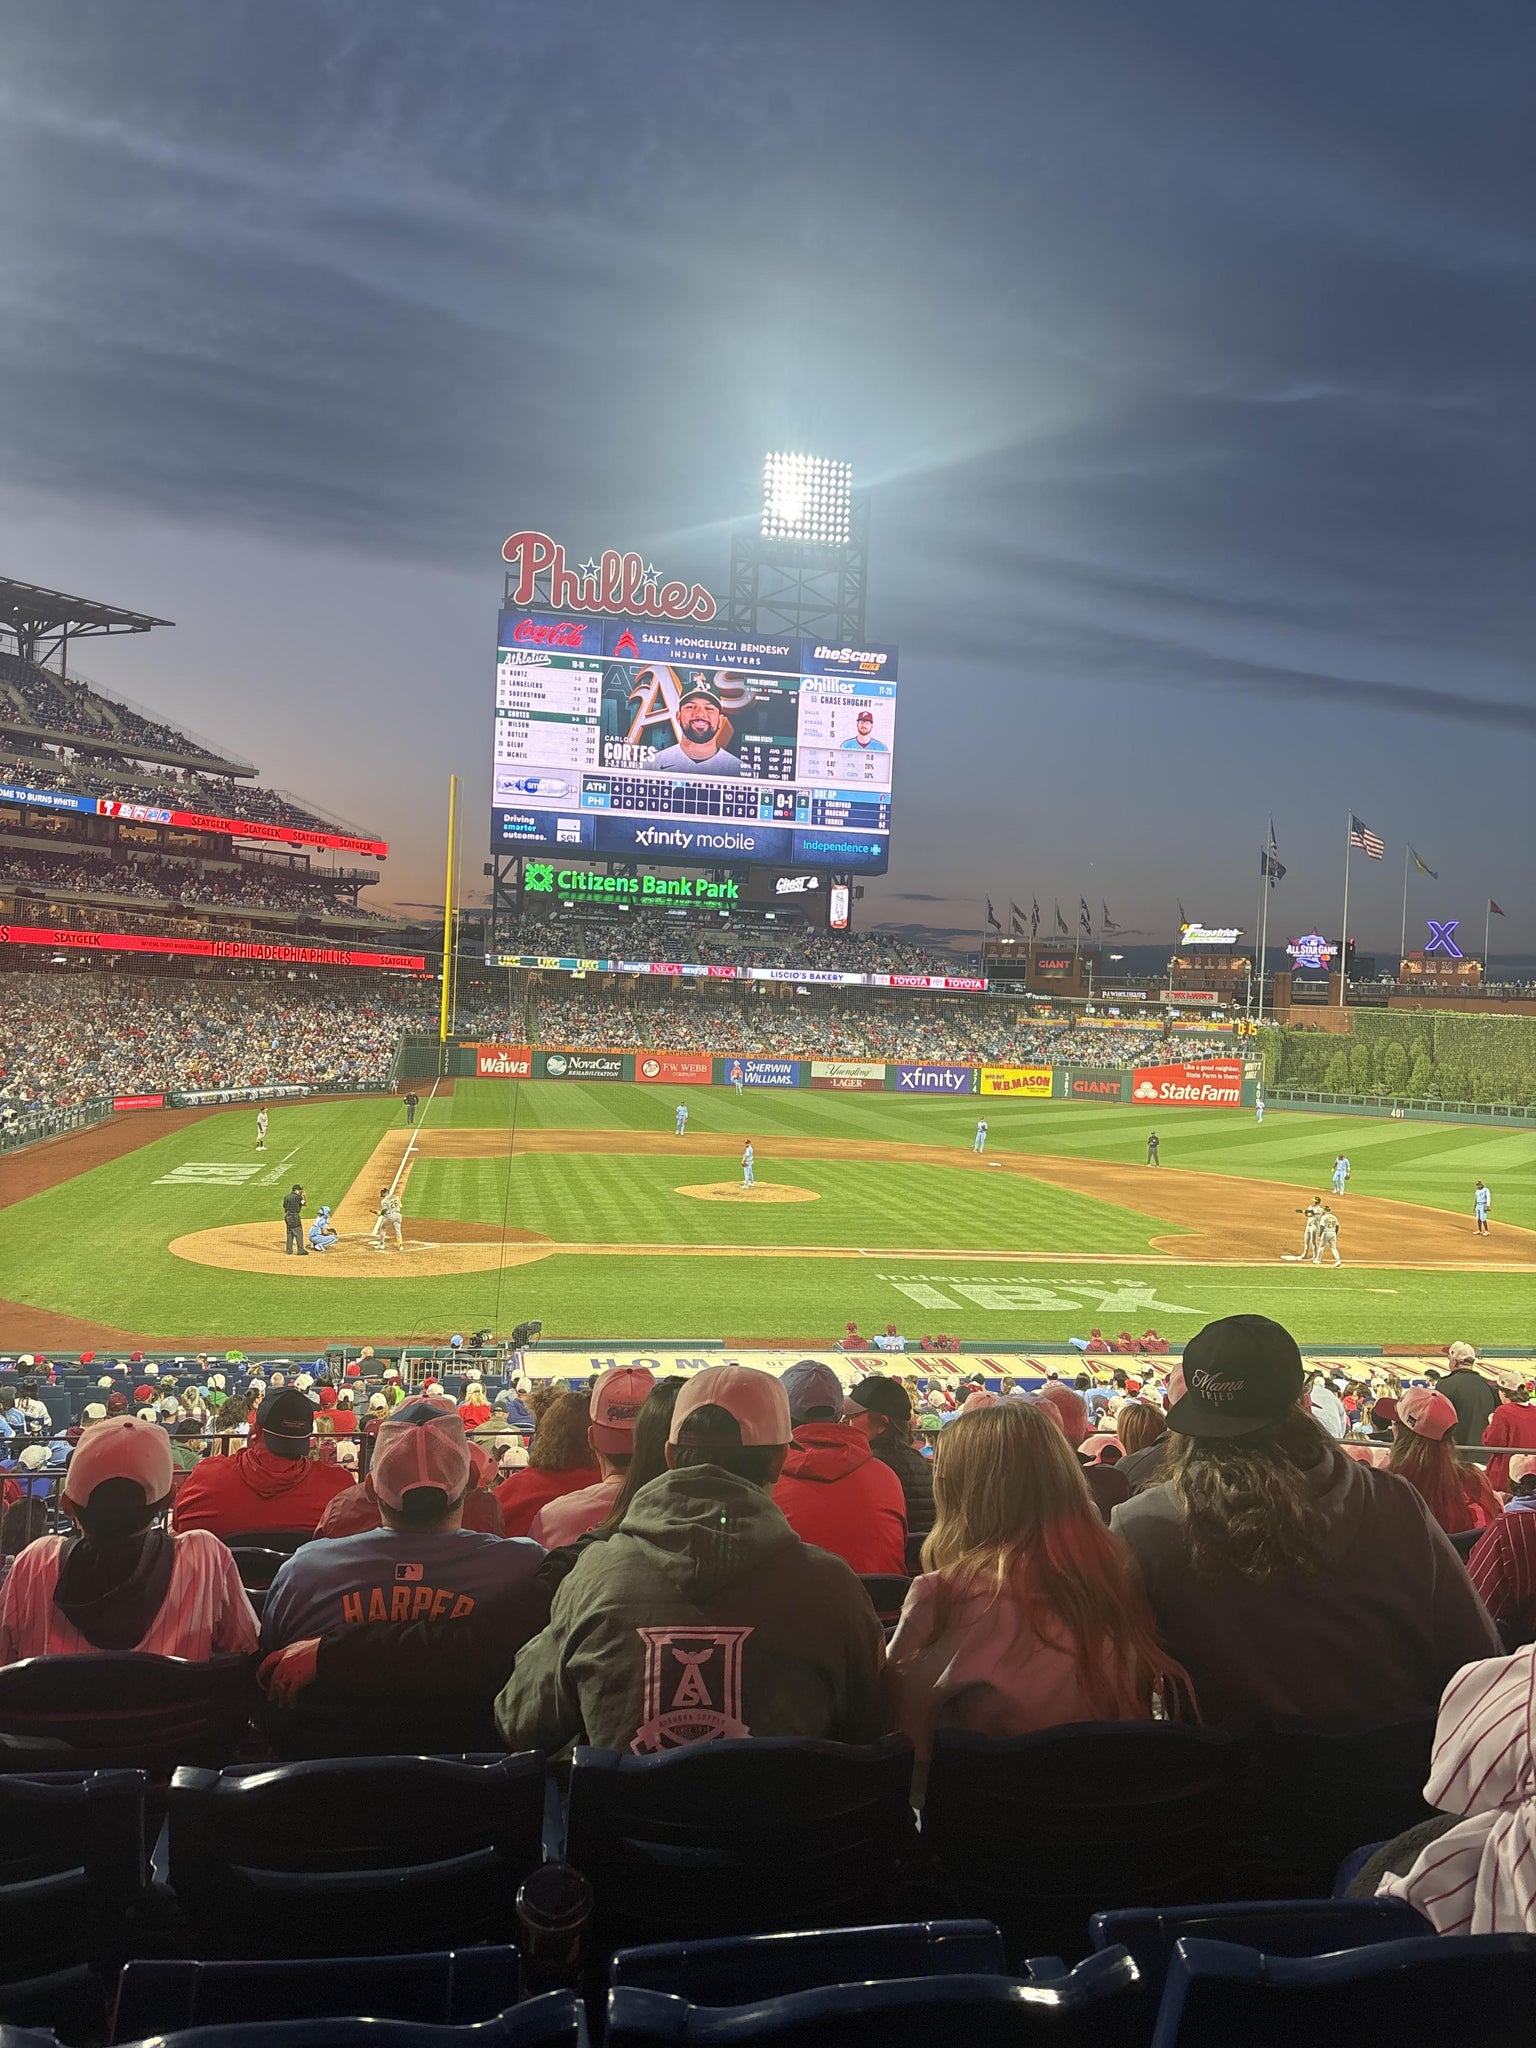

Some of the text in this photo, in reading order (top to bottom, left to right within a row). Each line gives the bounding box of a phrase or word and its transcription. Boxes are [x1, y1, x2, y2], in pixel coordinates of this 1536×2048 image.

[501, 530, 717, 622] Phillies
[642, 634, 790, 656] SALTZ MONGELUZZI BENDESKY
[503, 651, 552, 668] Athletics
[670, 650, 761, 666] INJURY LAWYERS
[814, 646, 888, 664] theScore
[800, 678, 856, 694] phillies
[820, 696, 841, 705] CHASE
[843, 698, 872, 707] SHUGART
[604, 735, 633, 743] CARLOS
[604, 742, 657, 763] CORTES
[586, 782, 606, 792] ATH
[16, 791, 26, 800] TO
[27, 793, 52, 804] BURNS
[814, 790, 827, 798] DUE
[828, 790, 837, 798] UP
[588, 797, 604, 805] PHI
[776, 794, 793, 808] 0-1
[192, 816, 231, 831] SEATGEEK
[503, 814, 535, 825] Driving
[244, 824, 281, 838] SEATGEEK
[503, 824, 537, 832] smarter
[293, 831, 328, 846] SEATGEEK
[503, 832, 547, 841] outcomes.
[635, 826, 755, 850] xfinity mobile
[339, 838, 372, 852] SEATGEEK
[803, 840, 869, 852] Independence
[557, 870, 739, 899] Citizens Bank Park
[776, 876, 811, 894] GHOST
[54, 932, 100, 946] SEATGEEK
[210, 941, 229, 956] THE
[233, 944, 307, 962] PHILADELPHIA
[310, 950, 352, 965] PHILLIES
[380, 956, 413, 967] SEATGEEK
[1286, 945, 1338, 955] ALL STAR GAME
[537, 957, 560, 968] UKG
[576, 959, 598, 970] UKG
[654, 964, 679, 973] NECA
[1038, 960, 1071, 969] GIANT
[710, 968, 736, 976] NECA
[770, 971, 844, 981] LISCIO'S BAKERY
[892, 976, 928, 986] TOYOTA
[947, 978, 982, 989] TOYOTA
[480, 1057, 528, 1074] Wawa
[568, 1057, 622, 1070] NovaCare
[681, 1064, 708, 1073] WEBB
[746, 1062, 791, 1073] SHERWIN
[826, 1064, 872, 1077] Yuengling
[745, 1072, 792, 1085] WILLIAMS.
[833, 1078, 863, 1088] LAGER
[901, 1067, 966, 1089] xfinity
[1073, 1080, 1120, 1094] GIANT
[1391, 1109, 1405, 1118] 401
[874, 1273, 1105, 1286] Independence
[890, 1283, 1210, 1314] IBX
[1192, 1369, 1244, 1391] Mama
[1200, 1390, 1234, 1400] TRIED
